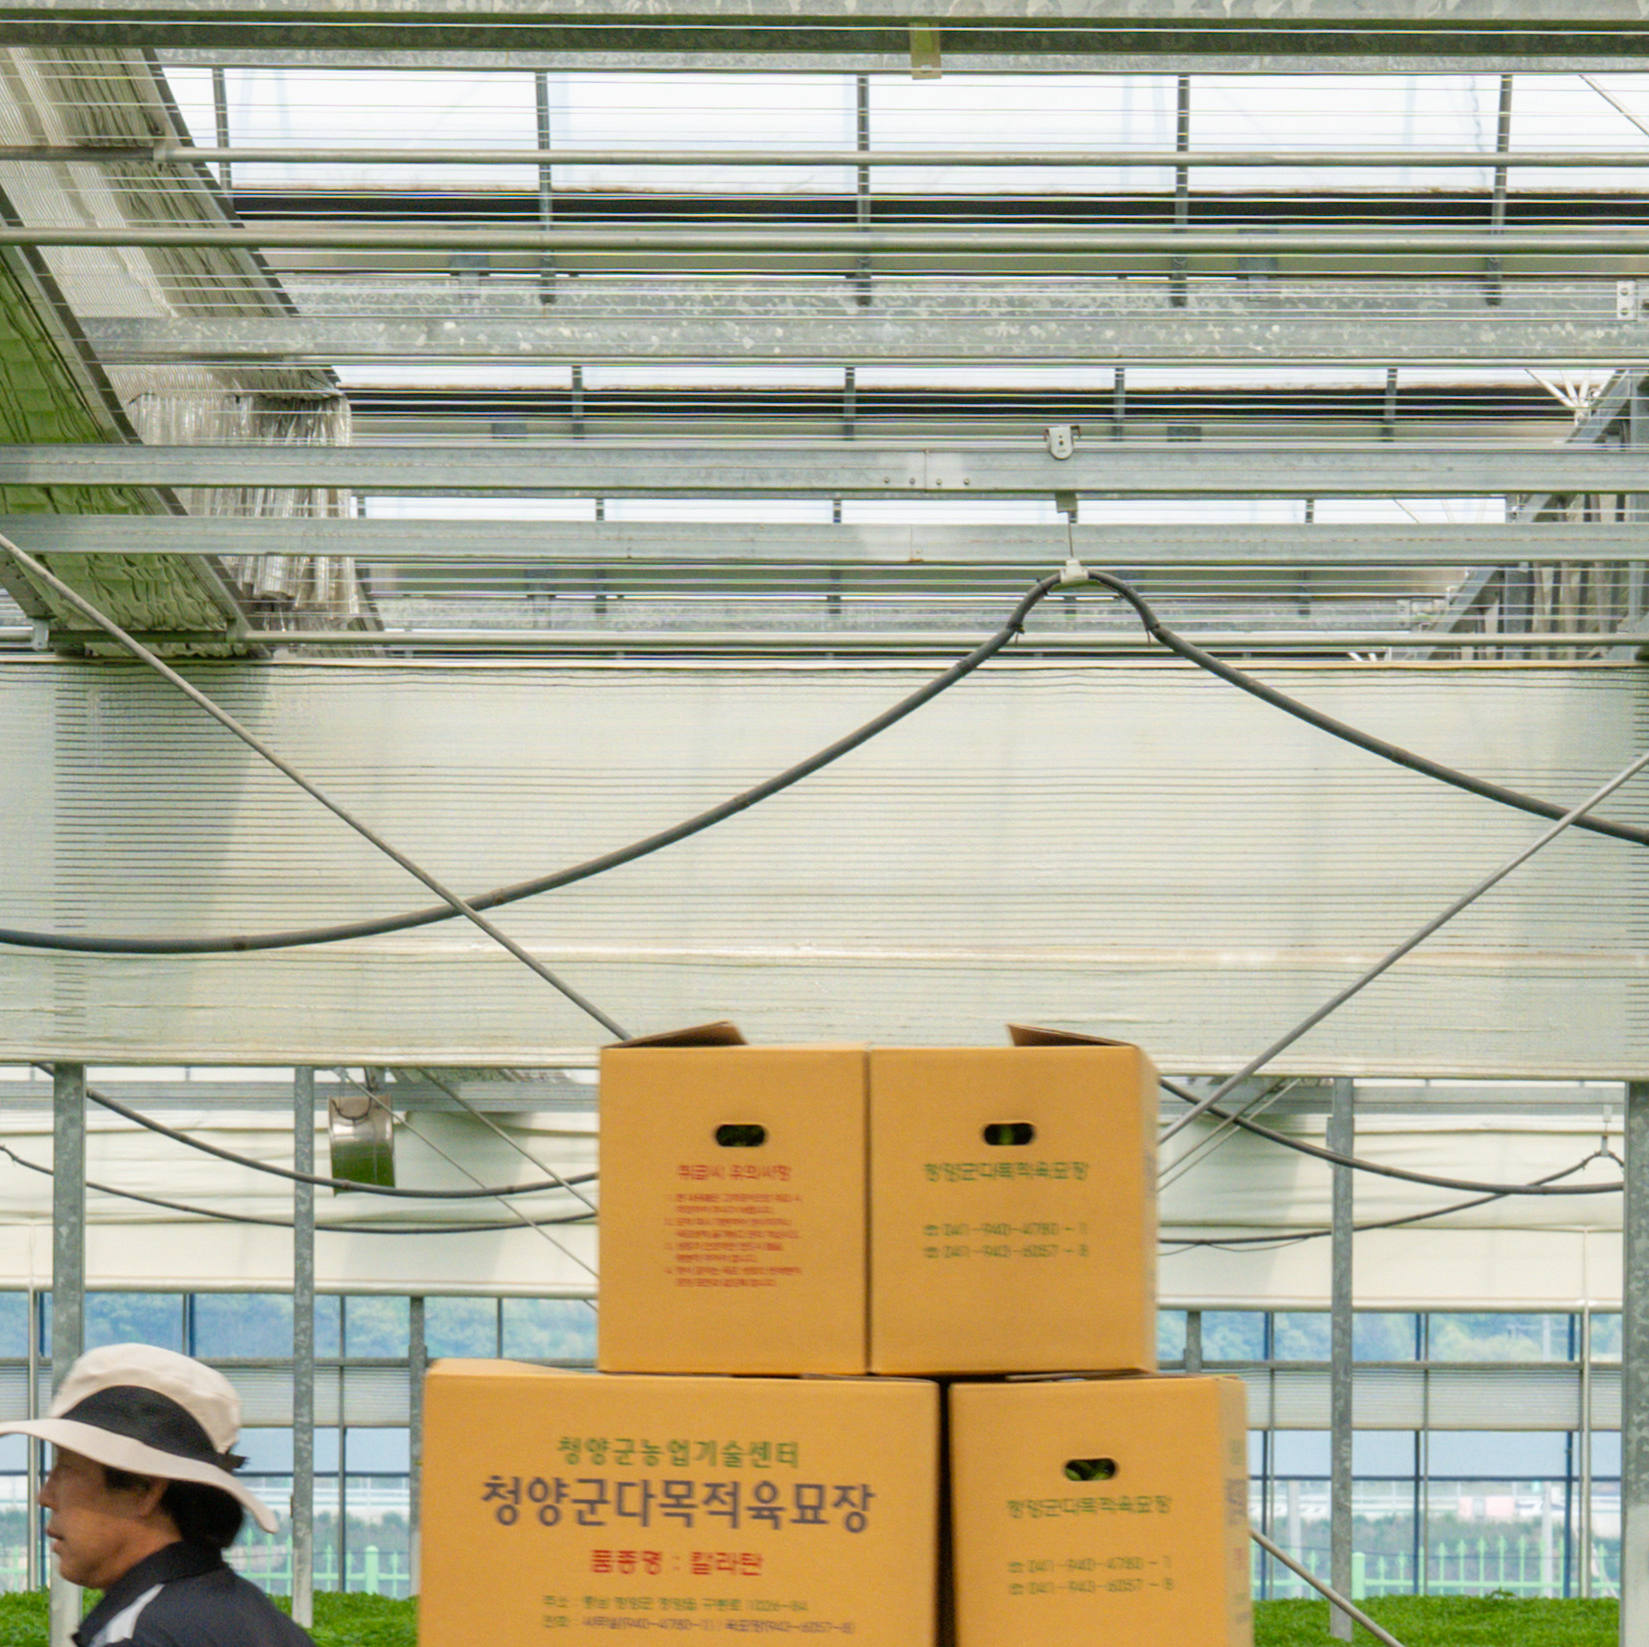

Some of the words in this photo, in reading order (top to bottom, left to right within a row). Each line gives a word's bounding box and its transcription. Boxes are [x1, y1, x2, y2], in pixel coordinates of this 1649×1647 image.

[923, 1162, 1089, 1183] 청양군다목적육묘장
[557, 1436, 800, 1469] 청양군농업기술센터
[482, 1475, 877, 1534] 청양군다목적육묘장
[1006, 1495, 1172, 1519] 청양군다목적육묘장
[590, 1549, 663, 1576] 품종명
[689, 1551, 765, 1577] 칼라탄
